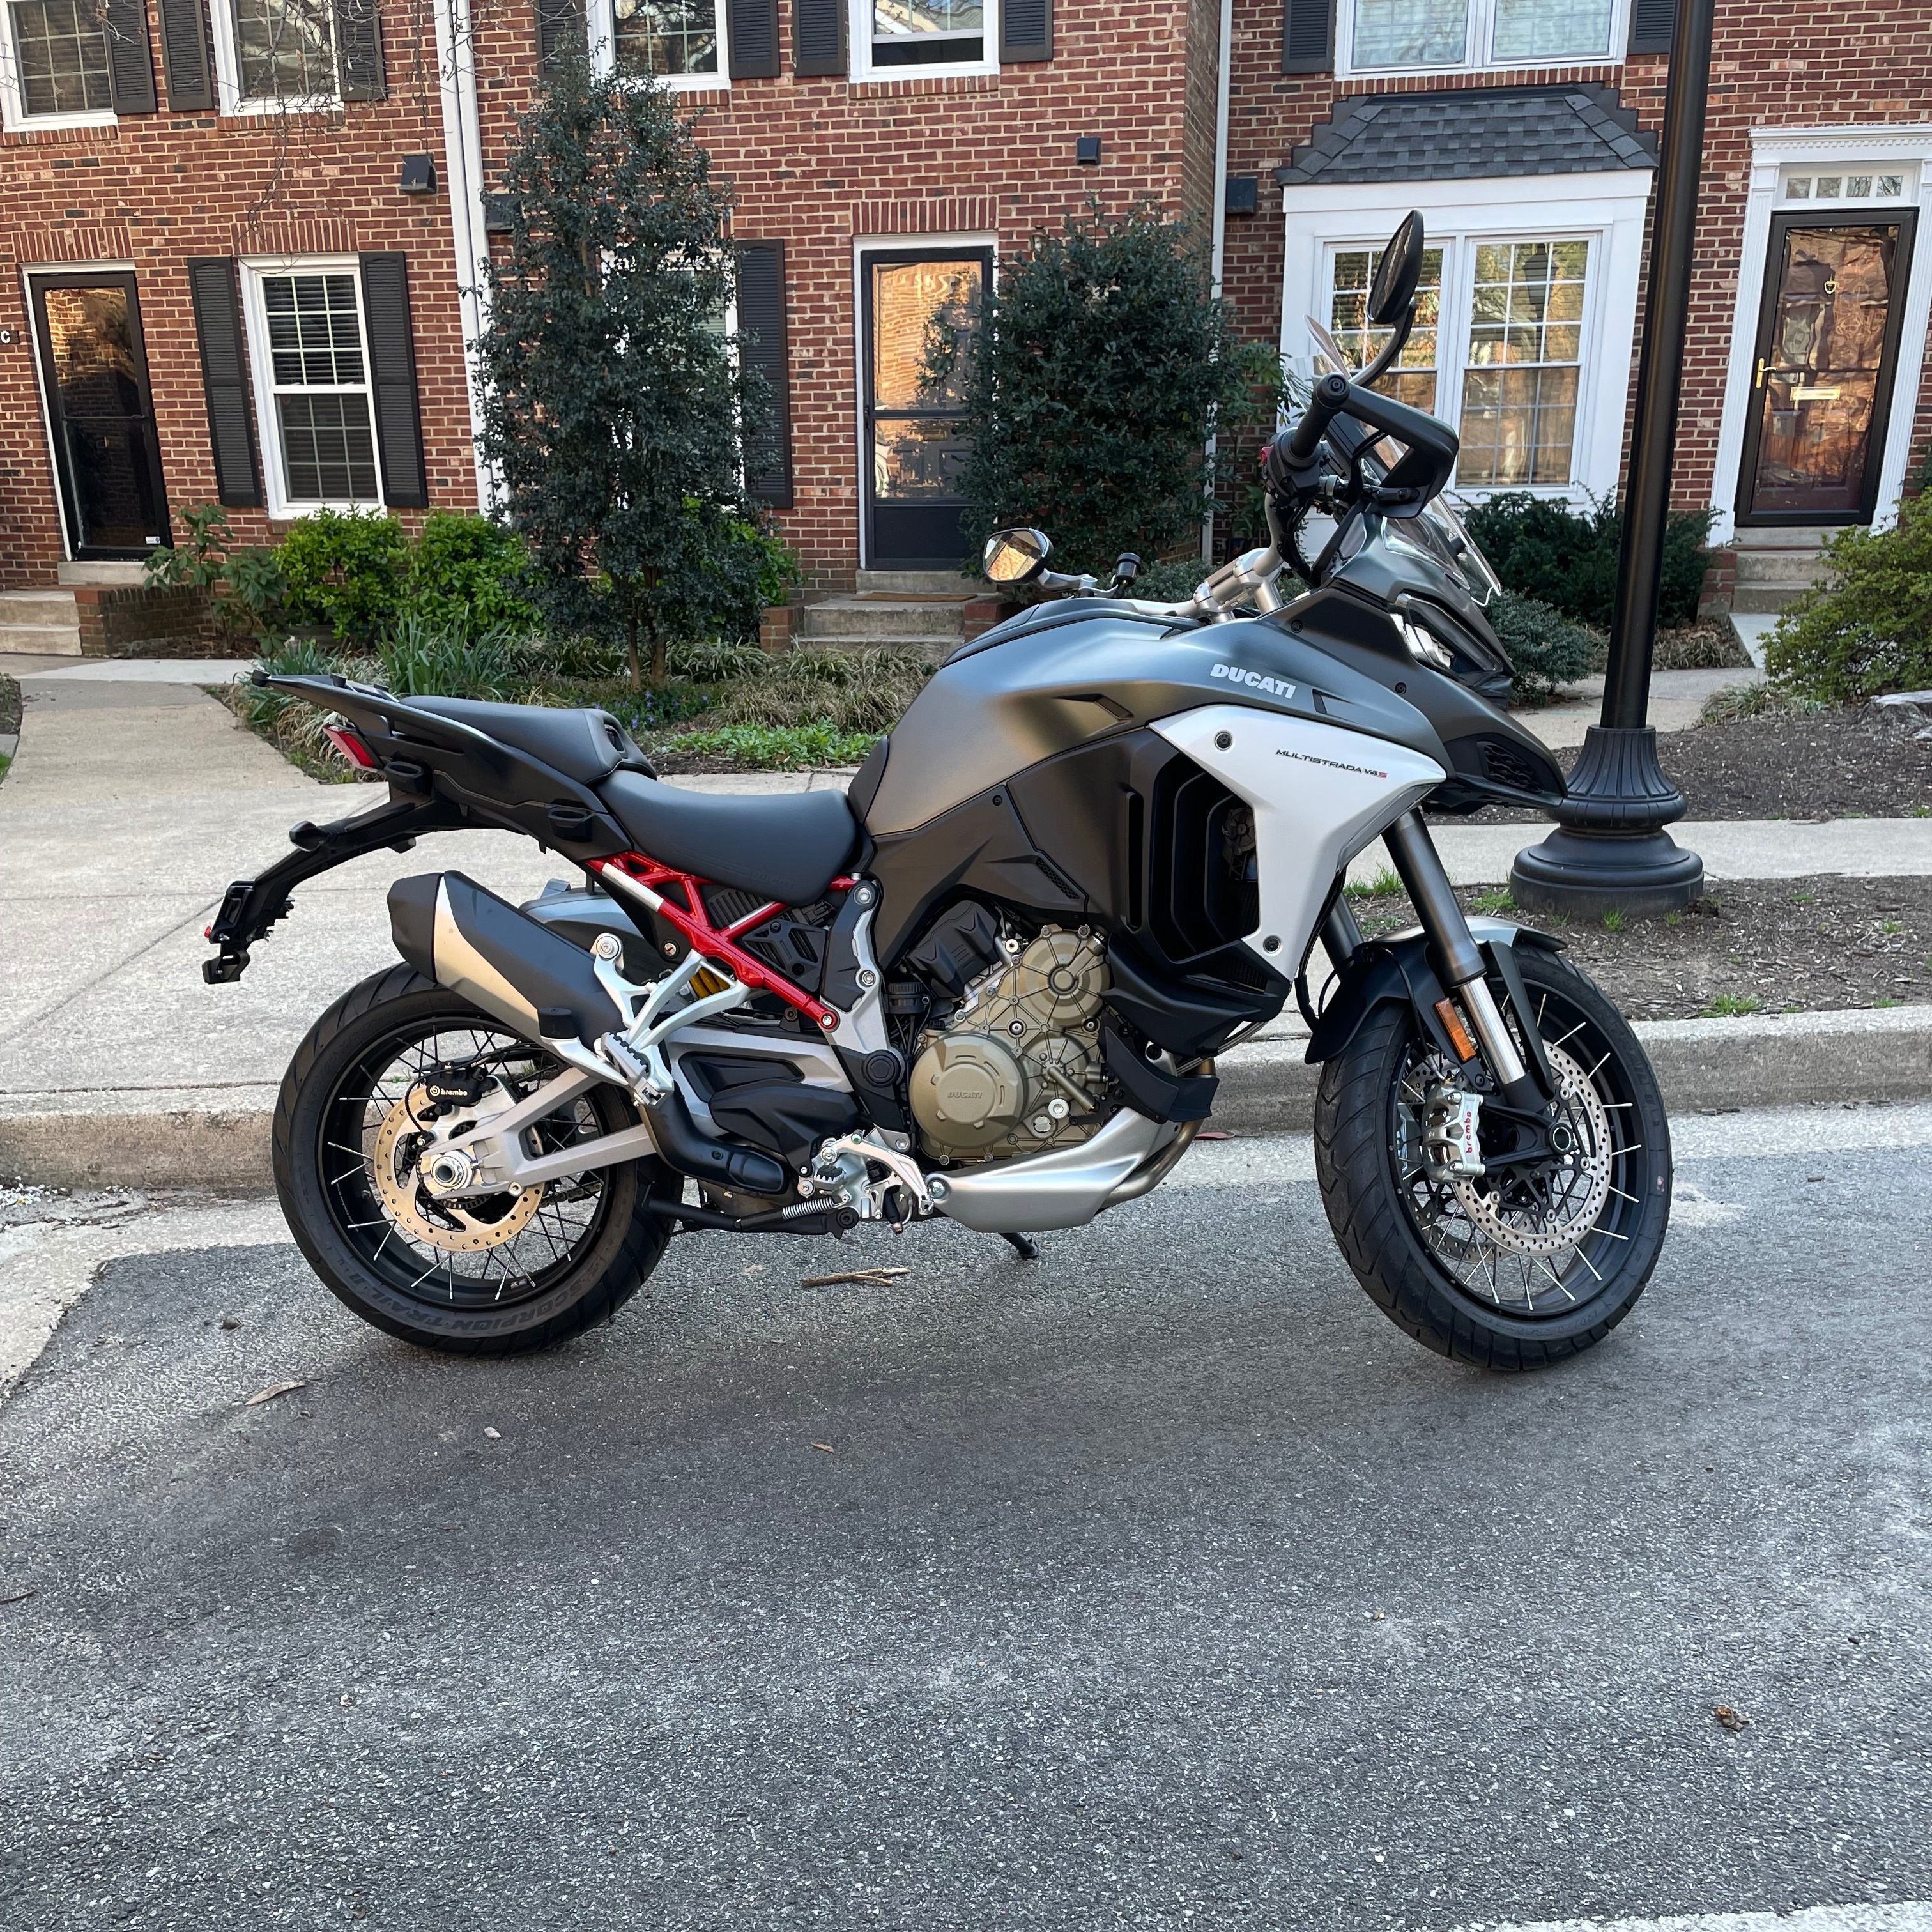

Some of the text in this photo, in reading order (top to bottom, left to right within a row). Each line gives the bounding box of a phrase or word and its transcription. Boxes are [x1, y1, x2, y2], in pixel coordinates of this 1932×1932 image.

[1209, 663, 1296, 700] DUCATI
[1275, 749, 1363, 774] MULTISTRADA
[441, 1087, 468, 1096] brembo
[947, 1091, 983, 1100] DUCATI
[1464, 1111, 1473, 1153] brembo
[371, 1286, 443, 1327] TRAIL
[450, 1279, 583, 1331] SCORPION
